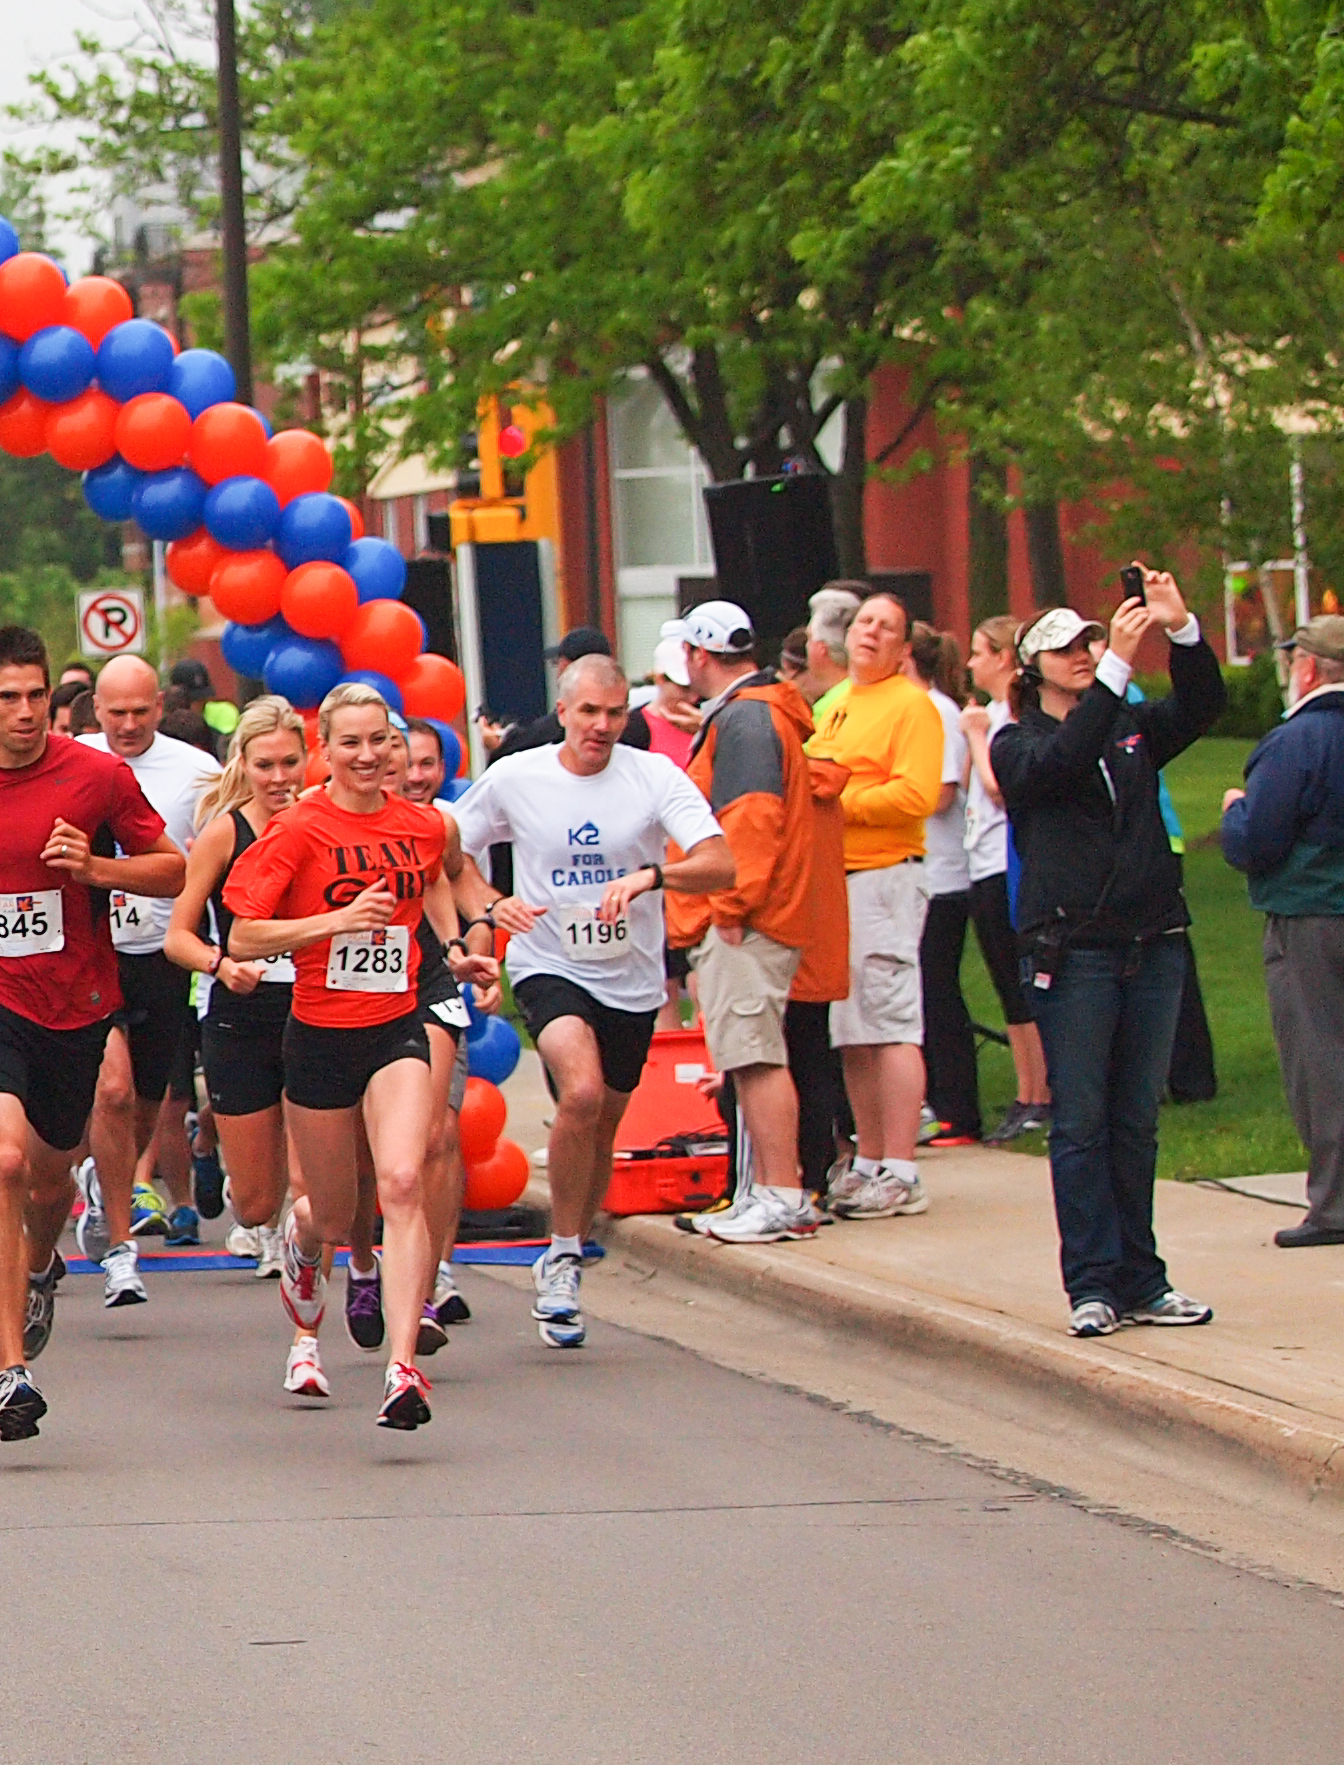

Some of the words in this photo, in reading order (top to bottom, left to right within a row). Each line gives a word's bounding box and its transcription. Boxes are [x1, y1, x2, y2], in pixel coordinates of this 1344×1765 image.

[568, 821, 600, 846] K2
[329, 839, 422, 875] TEAM
[572, 853, 605, 867] FOR
[566, 919, 627, 945] 1196
[335, 945, 403, 974] 1283
